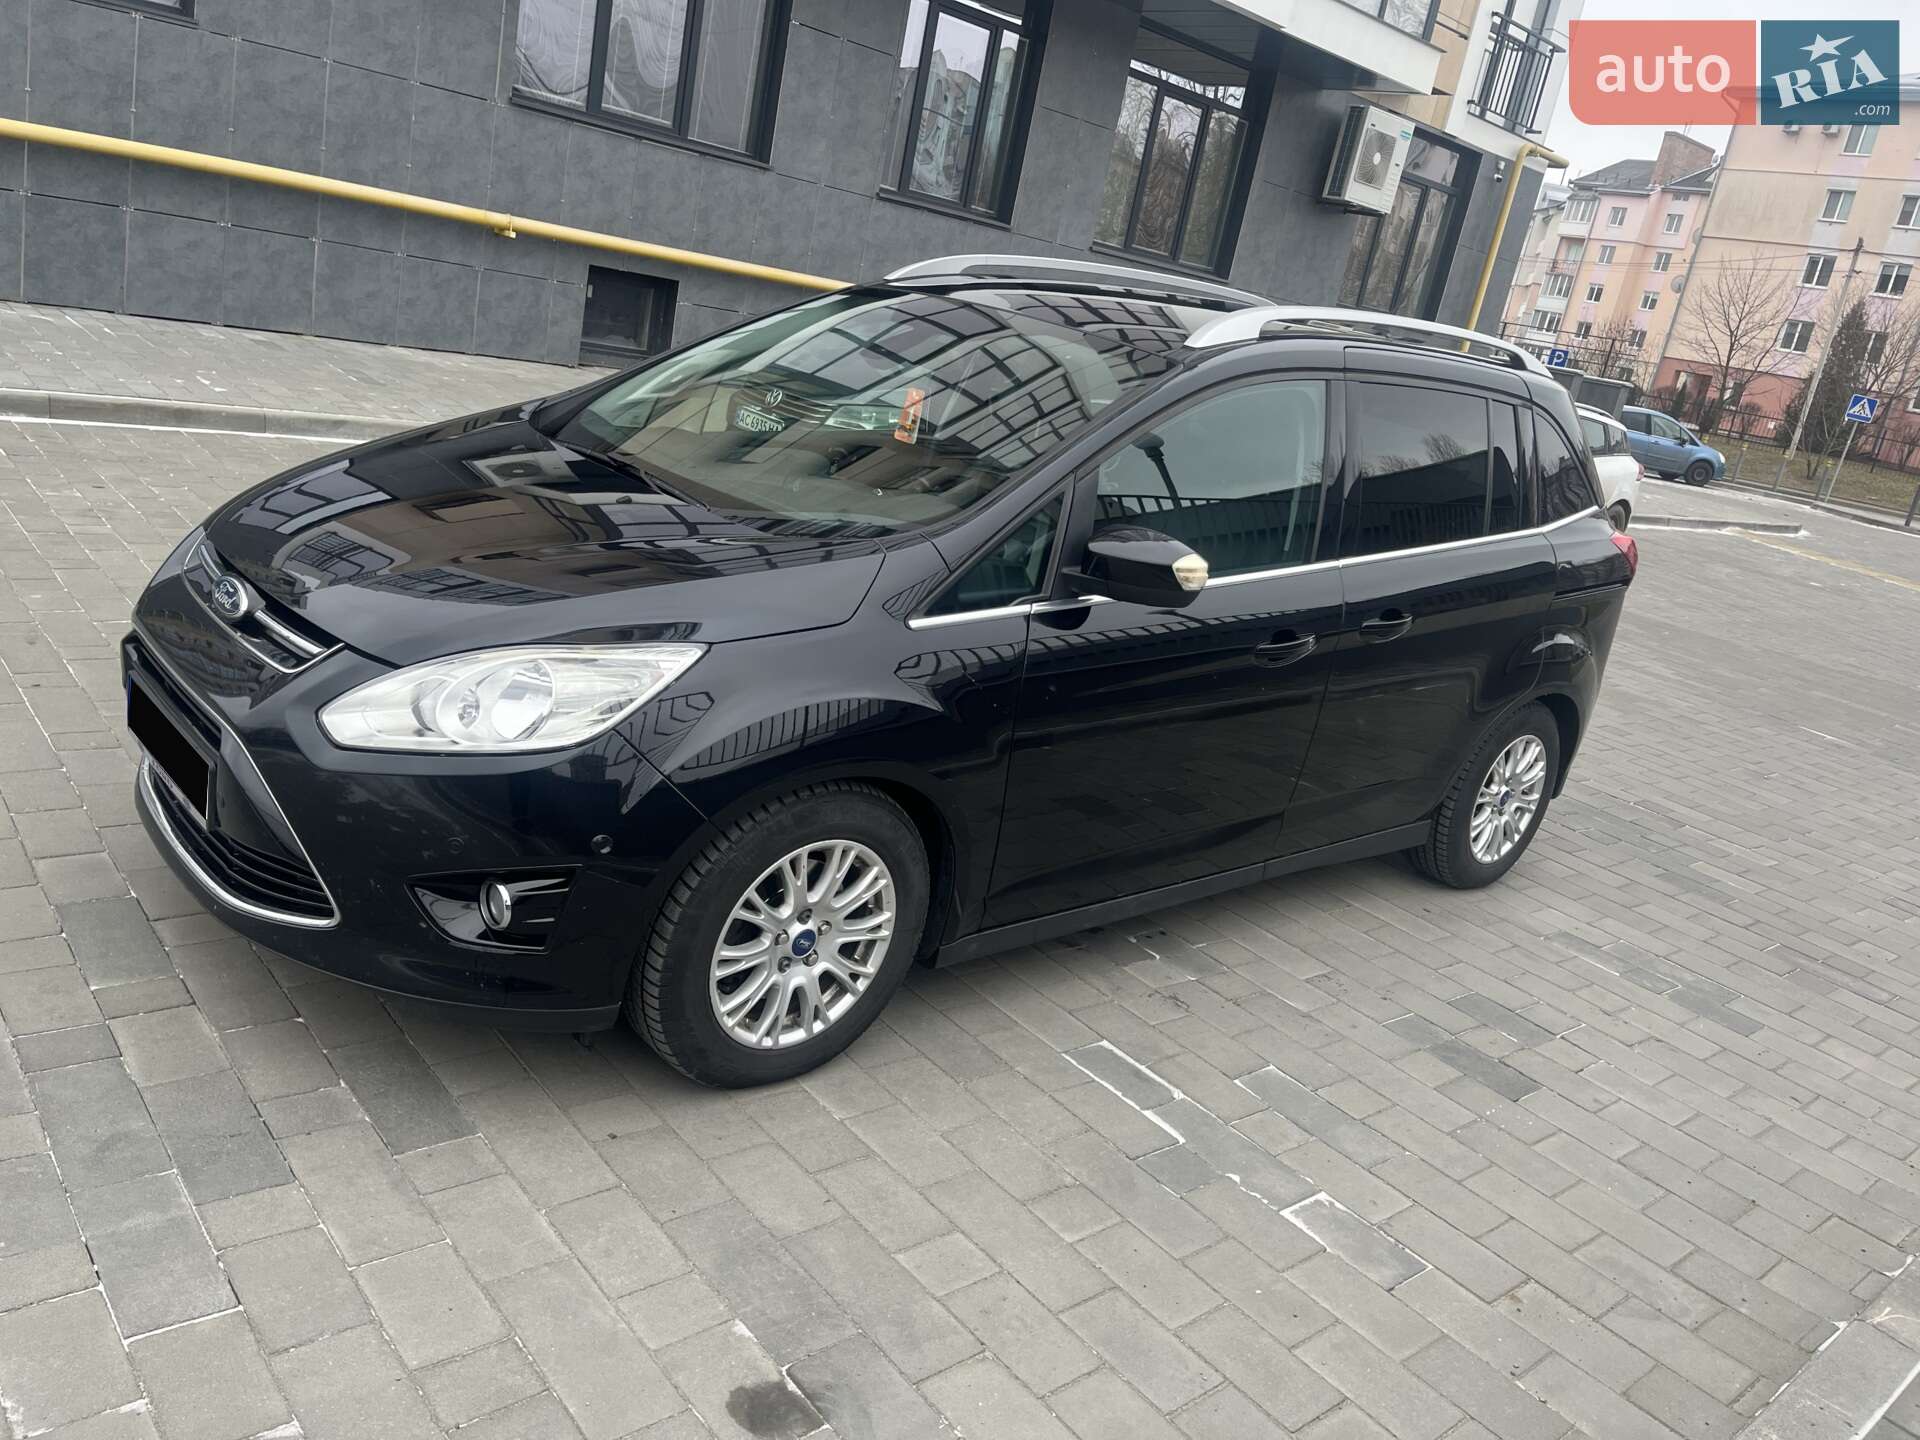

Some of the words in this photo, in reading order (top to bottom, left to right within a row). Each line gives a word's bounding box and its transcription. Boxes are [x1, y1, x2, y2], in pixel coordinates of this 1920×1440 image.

[1552, 351, 1565, 366] P
[740, 411, 751, 426] AC
[216, 581, 237, 608] Ford
